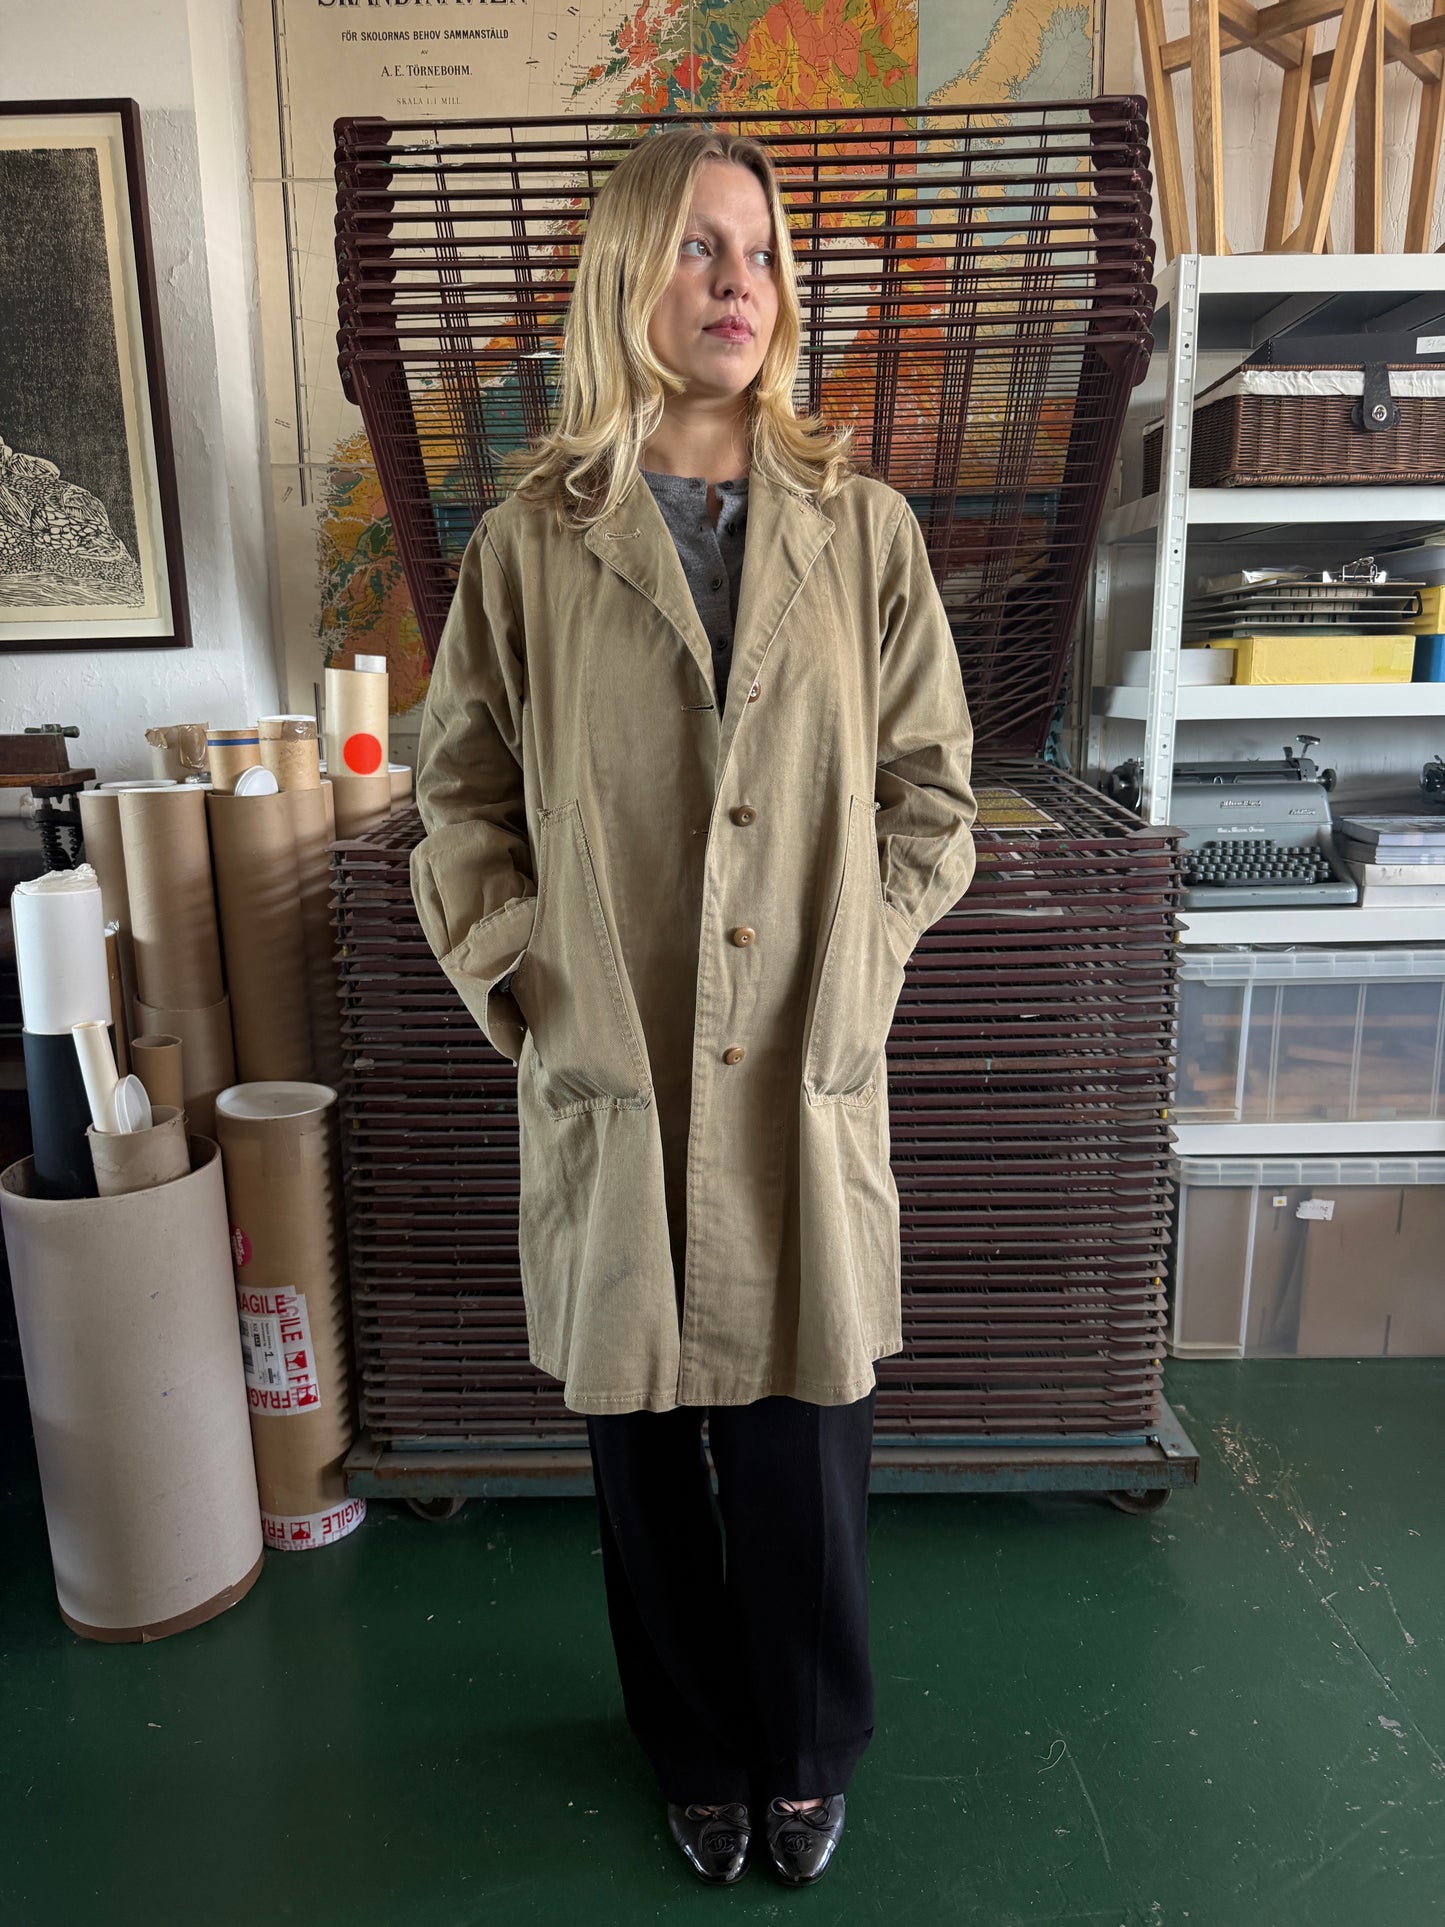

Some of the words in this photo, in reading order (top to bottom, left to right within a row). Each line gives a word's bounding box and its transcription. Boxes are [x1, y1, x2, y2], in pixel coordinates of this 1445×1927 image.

[341, 30, 357, 41] FÖR
[361, 31, 410, 40] SKOLORNAS
[413, 30, 441, 40] BEHOV
[444, 27, 509, 39] SAMMANSTÄLLD
[381, 65, 392, 77] A.
[395, 65, 404, 76] E.
[406, 64, 473, 76] TÖRNEBOHM.
[396, 97, 423, 105] SKALA
